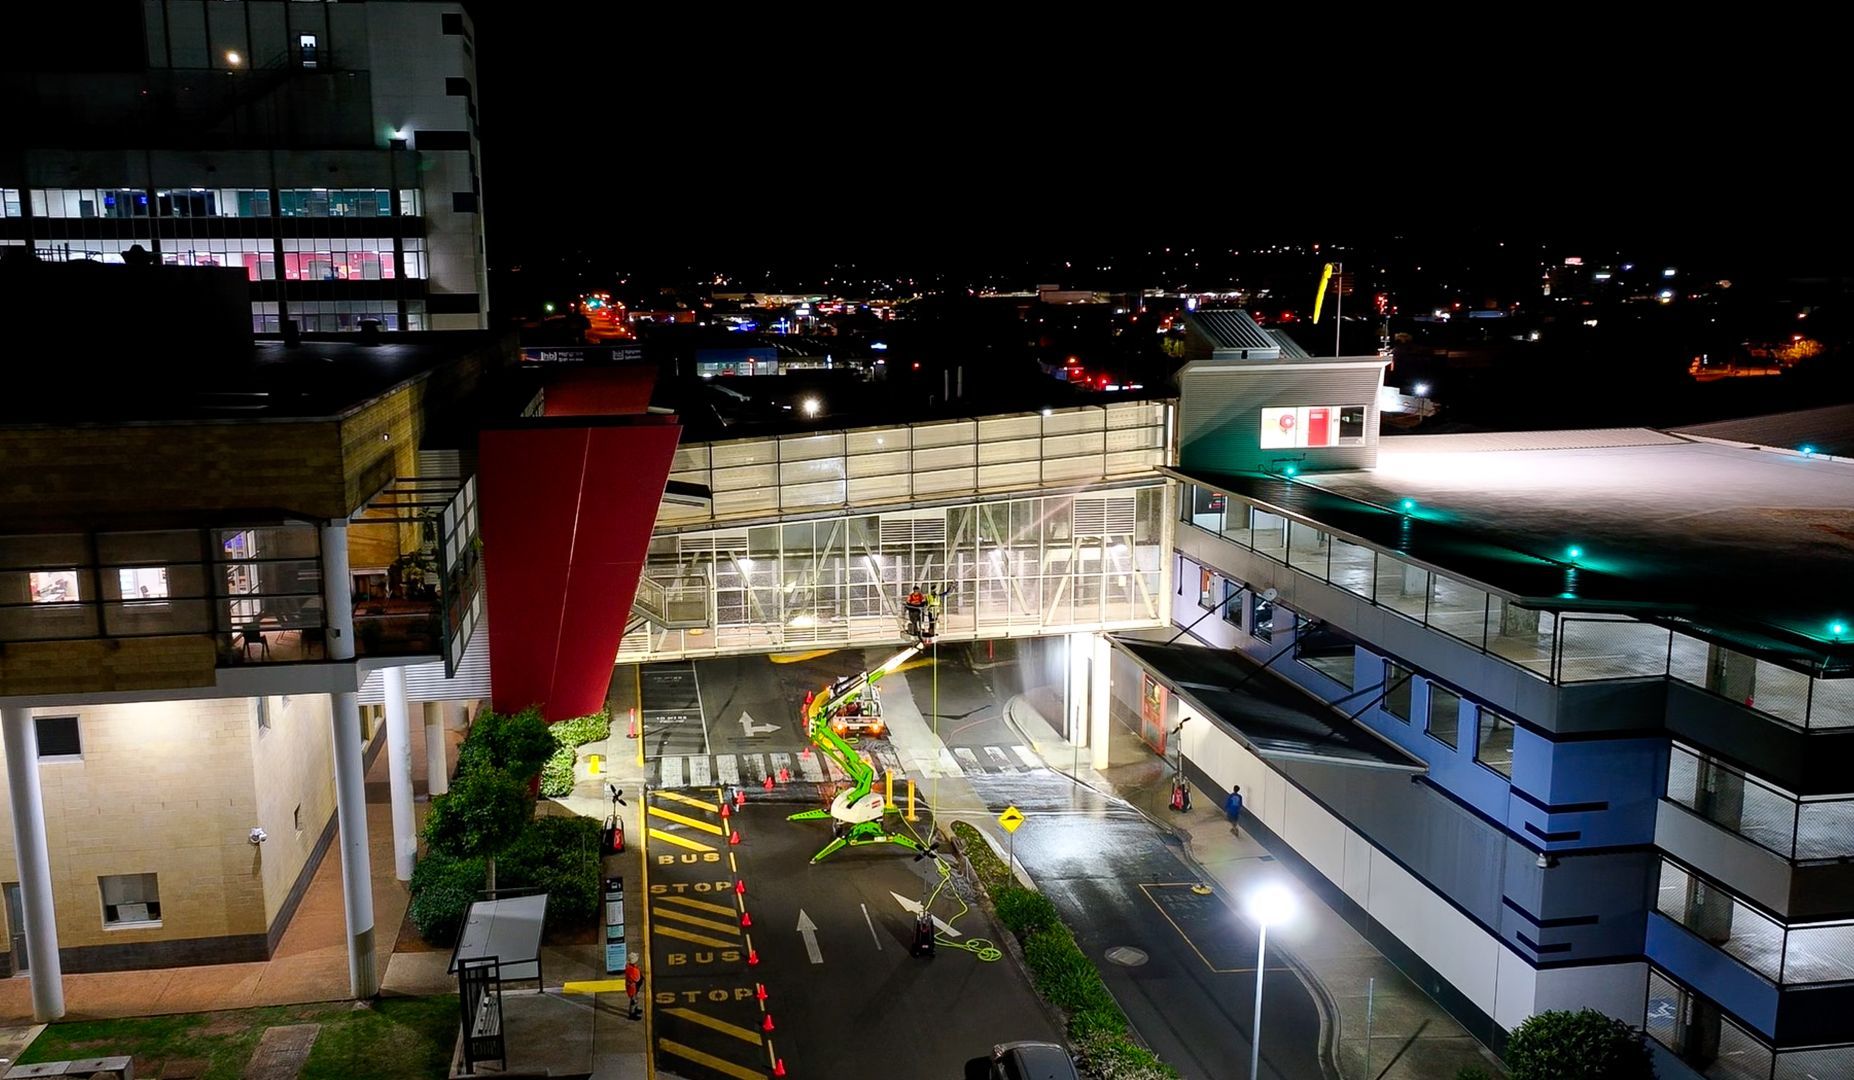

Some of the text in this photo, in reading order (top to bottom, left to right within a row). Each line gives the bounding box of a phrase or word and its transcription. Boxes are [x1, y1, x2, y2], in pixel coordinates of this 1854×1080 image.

[658, 852, 720, 865] BUS
[650, 881, 732, 894] STOP
[668, 950, 740, 966] BUS
[655, 988, 754, 1004] STOP
